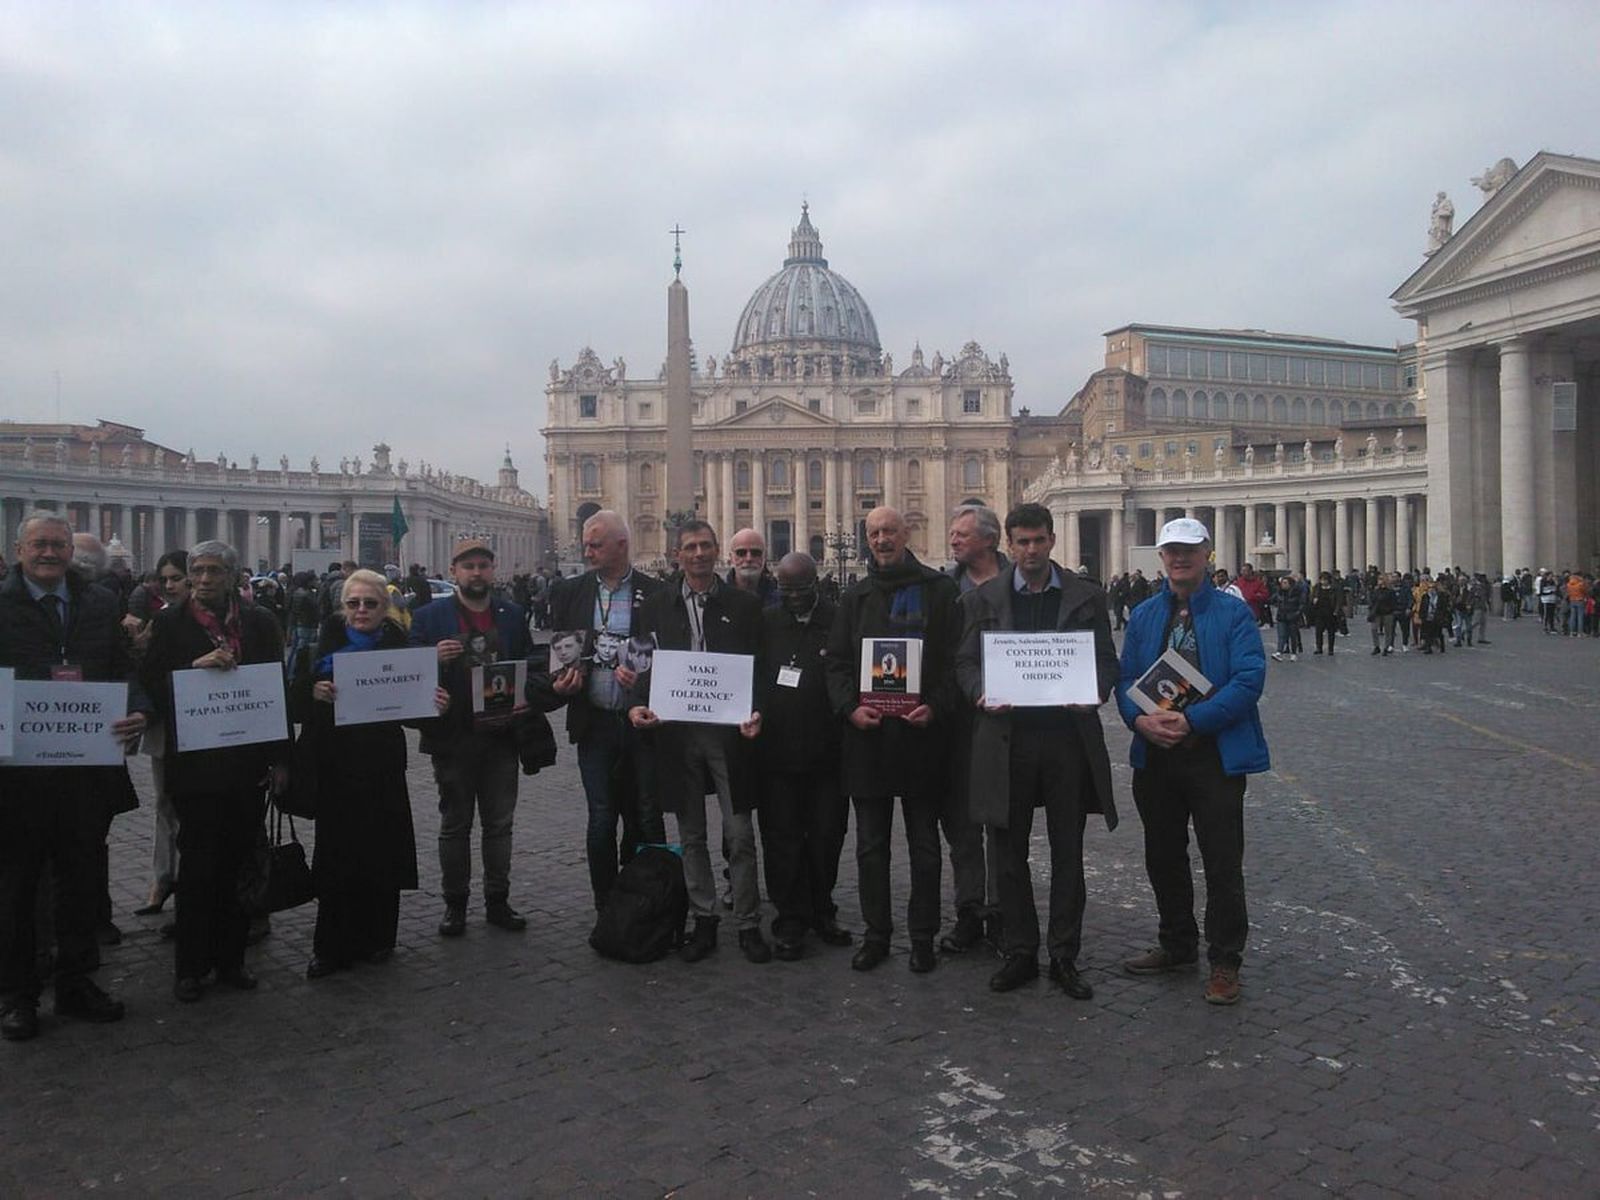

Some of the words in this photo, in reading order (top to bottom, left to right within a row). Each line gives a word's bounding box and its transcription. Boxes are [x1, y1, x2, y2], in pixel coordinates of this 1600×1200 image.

[1006, 648, 1054, 657] CONTROL
[1056, 647, 1078, 657] THE
[382, 663, 395, 673] BE
[1014, 658, 1070, 668] RELIGIOUS
[688, 665, 718, 675] MAKE
[355, 673, 423, 687] TRANSPARENT
[1022, 671, 1064, 681] ORDERS
[208, 691, 229, 701] END
[230, 688, 252, 699] THE
[25, 701, 49, 713] NO
[54, 701, 102, 713] MORE
[687, 703, 715, 713] REAL
[20, 721, 104, 734] COVER-UP
